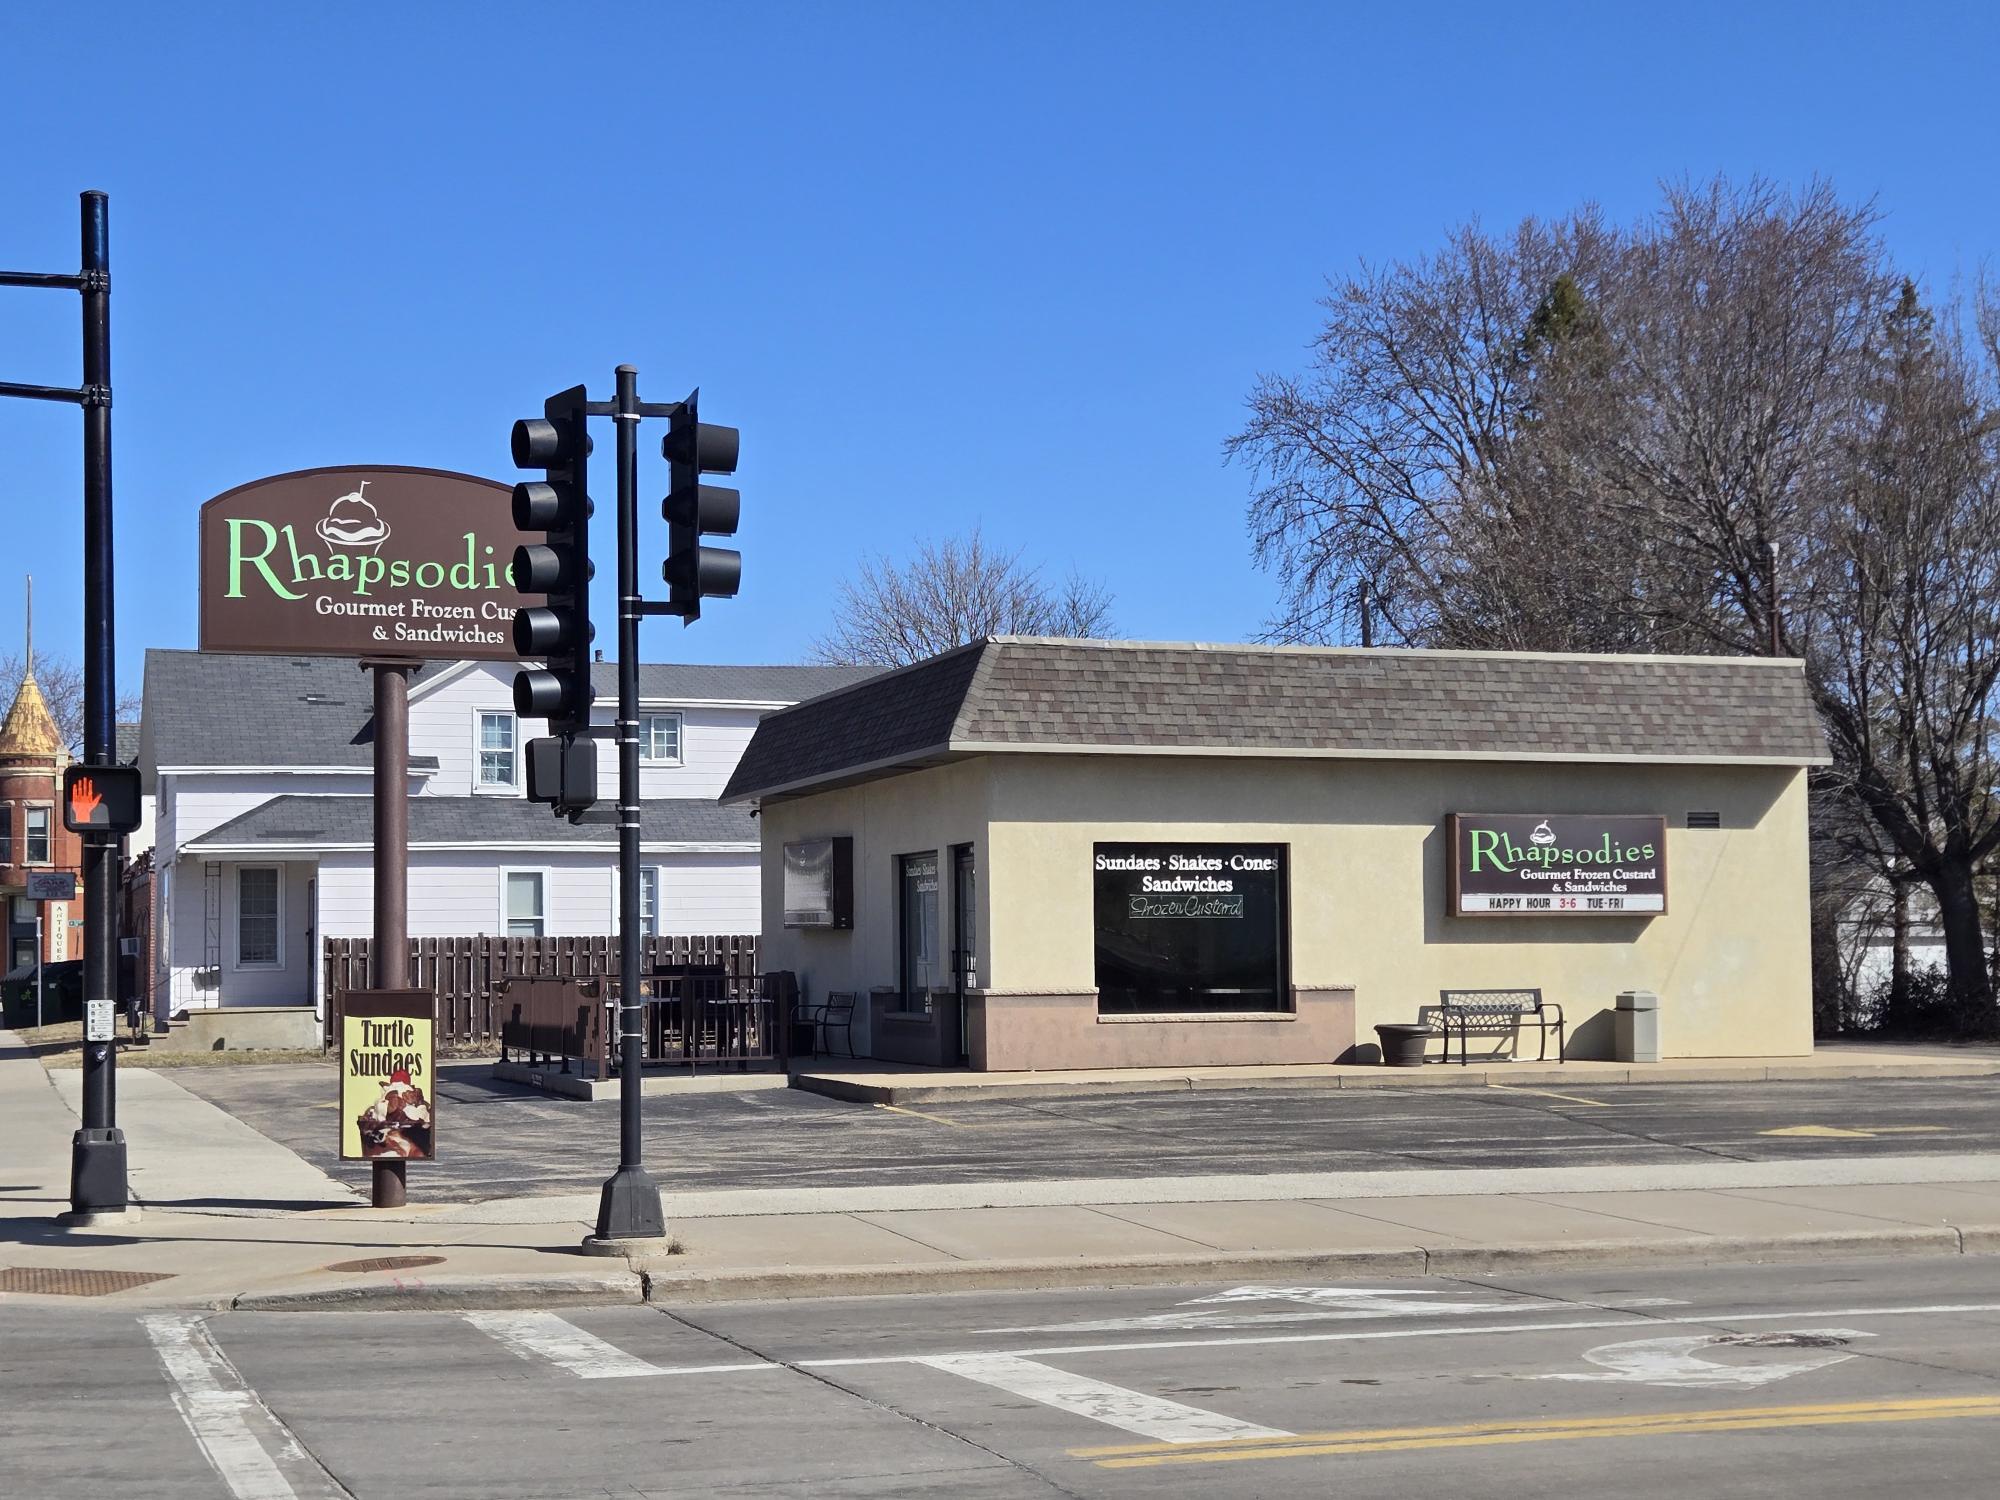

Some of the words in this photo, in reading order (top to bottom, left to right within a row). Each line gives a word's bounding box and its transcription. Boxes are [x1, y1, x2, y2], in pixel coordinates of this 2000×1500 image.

[315, 595, 406, 617] Gourmet
[411, 598, 476, 619] Frozen
[372, 625, 390, 641] &
[394, 622, 504, 644] Sandwiches
[1469, 829, 1655, 872] Rhapsodies
[1095, 854, 1161, 871] Sundaes
[1169, 854, 1223, 871] Shakes
[1231, 854, 1279, 871] Cones
[1142, 875, 1233, 892] Sandwiches
[1520, 868, 1573, 880] Gourmet
[1574, 869, 1611, 880] Frozen
[1612, 868, 1656, 880] Custard
[1552, 883, 1562, 892] &
[1564, 881, 1627, 893] Sandwiches
[1131, 897, 1183, 916] Frozen
[1184, 895, 1242, 916] Custard
[1489, 897, 1521, 909] HAPPY
[1526, 897, 1551, 909] HOUR
[1559, 897, 1577, 909] 3-6
[1587, 897, 1624, 909] TUE-FRI
[361, 1020, 414, 1048] Turtle
[350, 1048, 423, 1077] Sundaes
